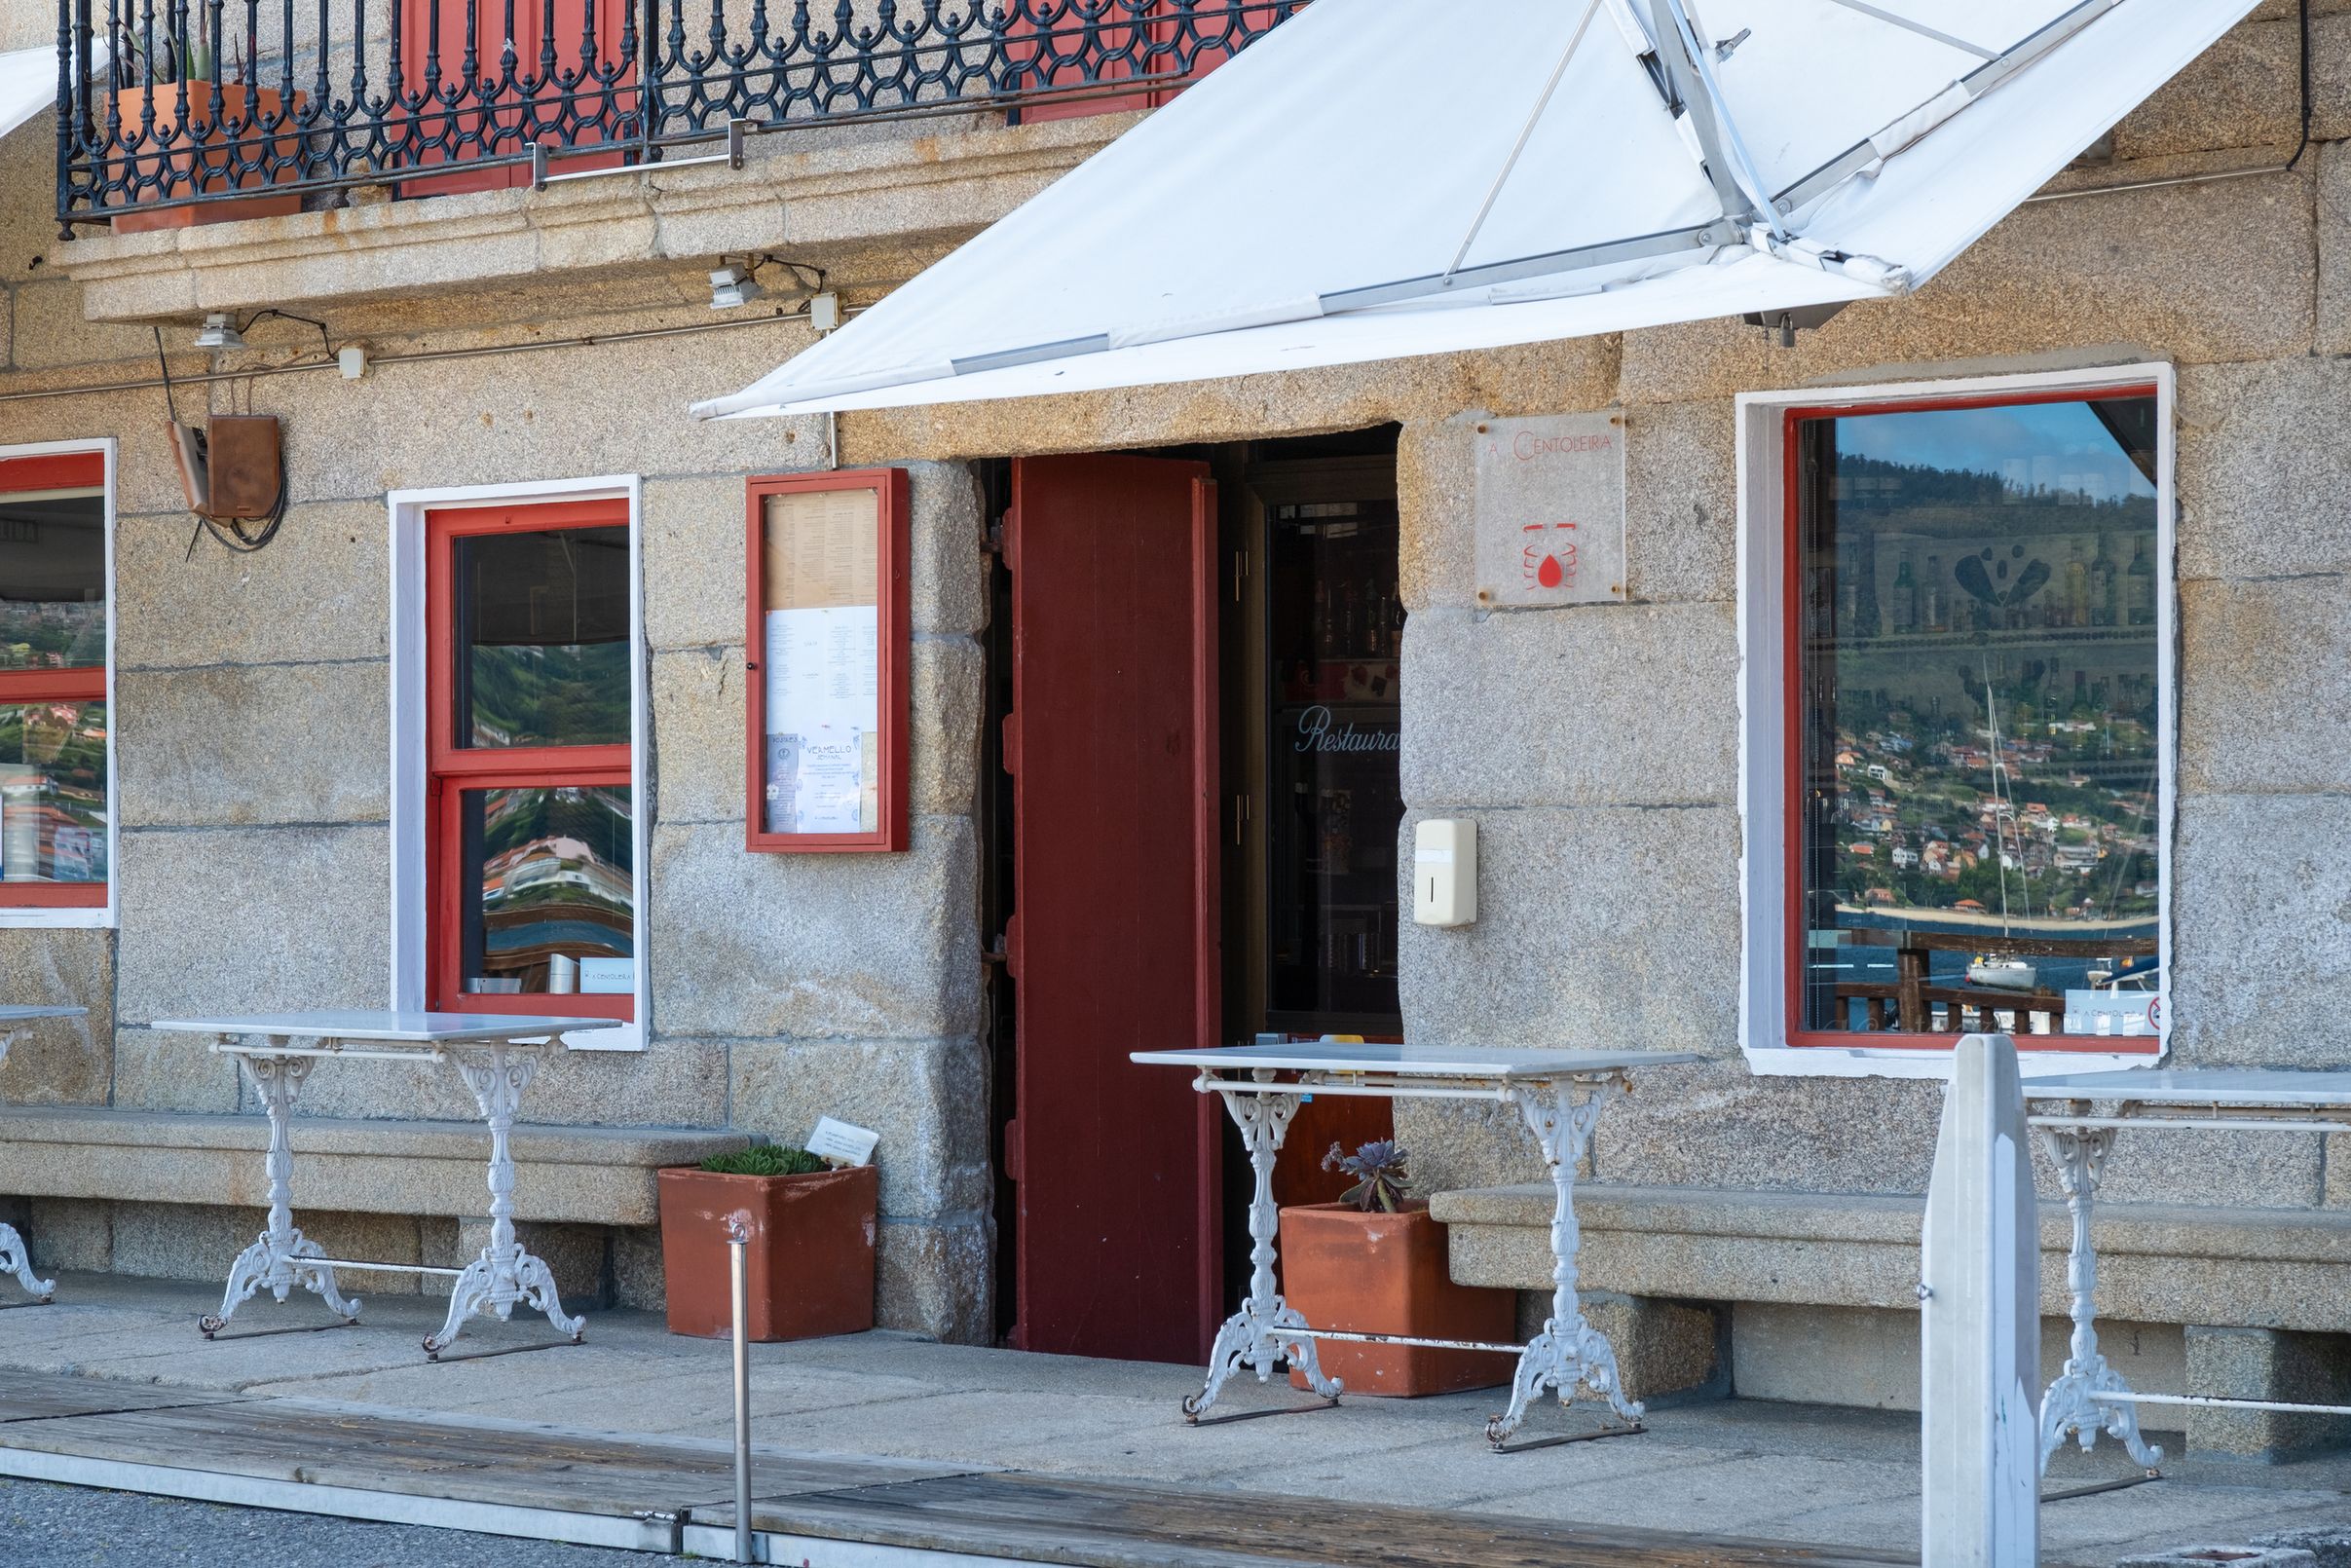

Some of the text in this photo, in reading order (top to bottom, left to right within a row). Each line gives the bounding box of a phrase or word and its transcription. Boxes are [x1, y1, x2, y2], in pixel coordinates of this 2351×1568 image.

[1487, 430, 1613, 461] A CENTOLEIRA
[1294, 704, 1400, 753] Restaura
